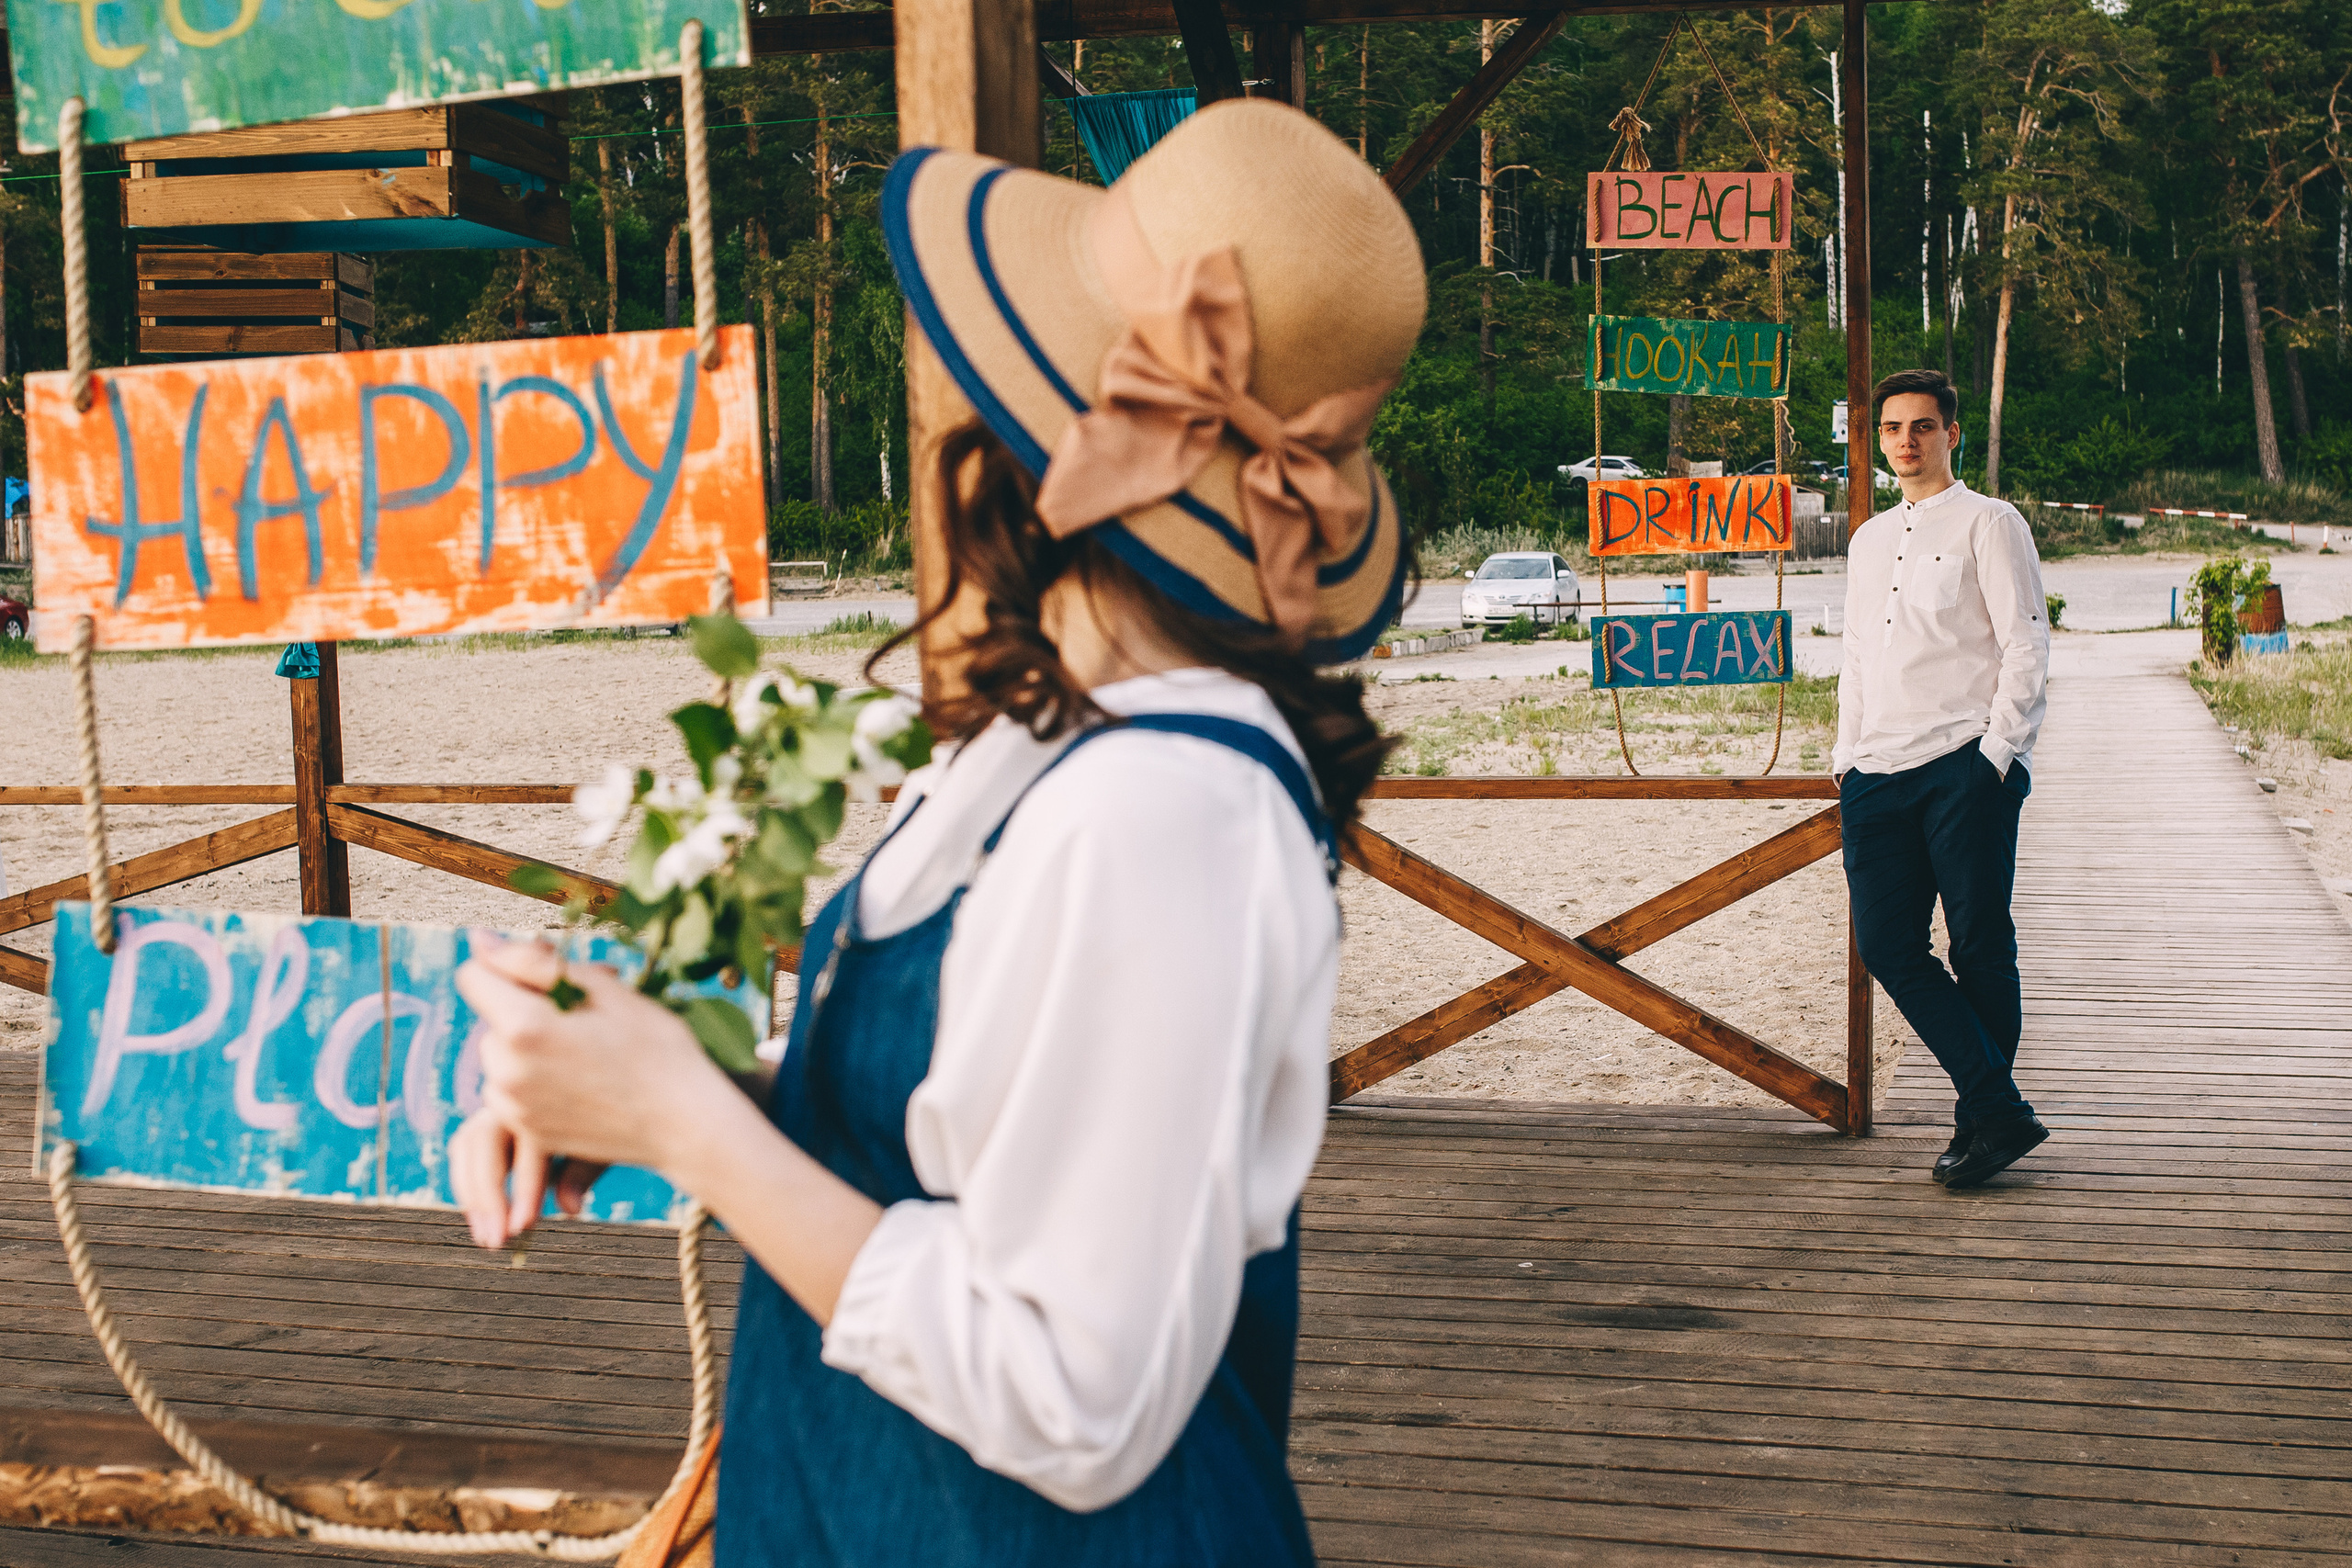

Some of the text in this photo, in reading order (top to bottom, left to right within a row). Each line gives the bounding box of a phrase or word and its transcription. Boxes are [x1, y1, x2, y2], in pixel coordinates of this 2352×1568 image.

[1615, 175, 1781, 243] BEACH
[1593, 324, 1781, 389] HOOKAH
[85, 348, 697, 611] HAPPY
[1608, 617, 1780, 680] RELAX
